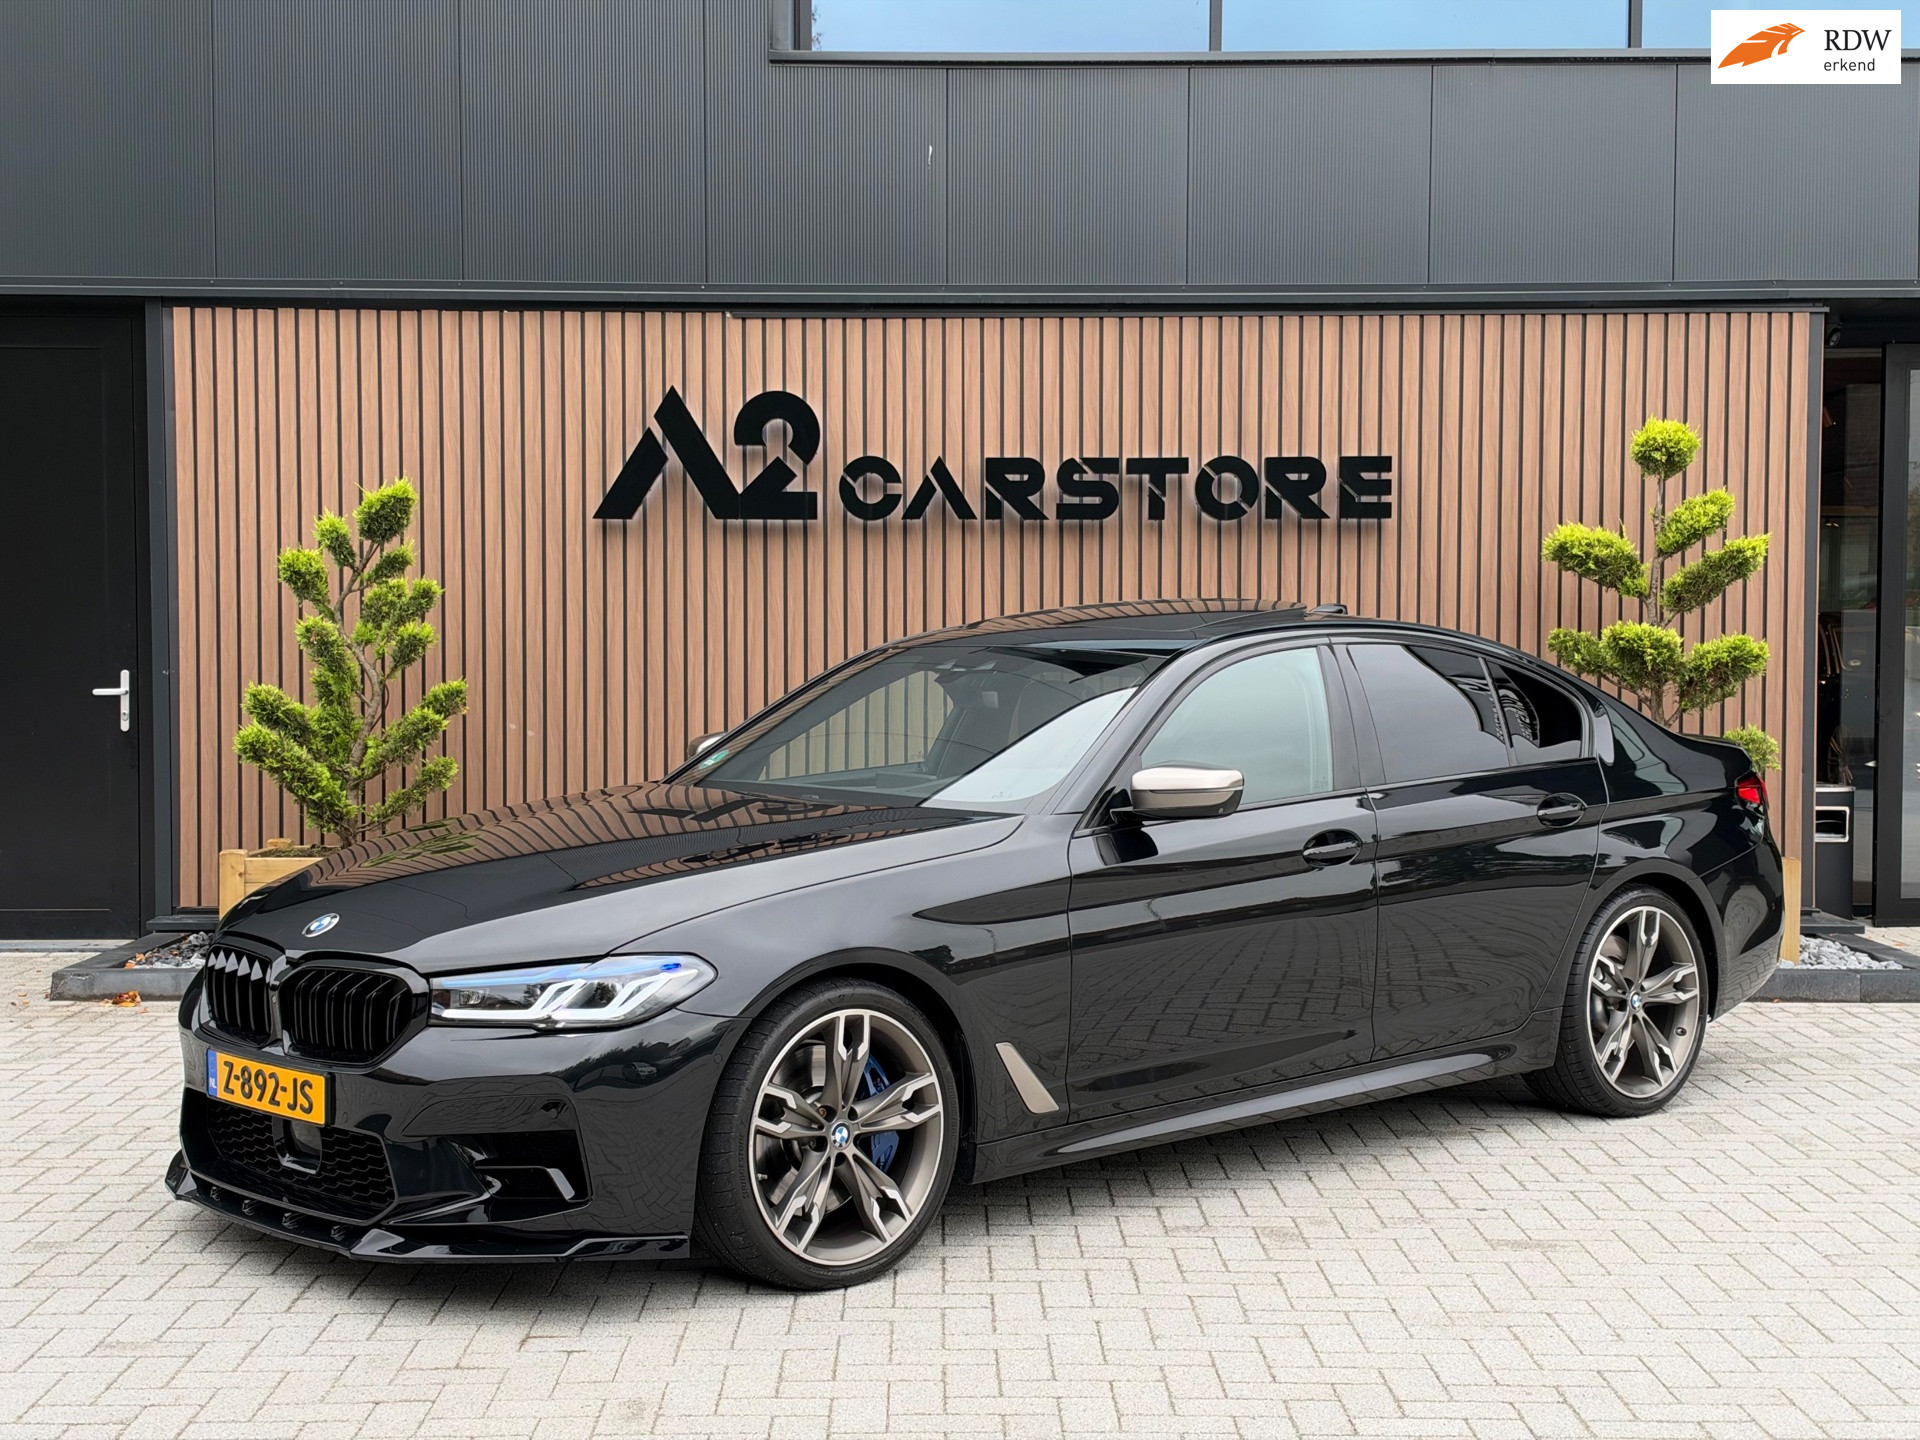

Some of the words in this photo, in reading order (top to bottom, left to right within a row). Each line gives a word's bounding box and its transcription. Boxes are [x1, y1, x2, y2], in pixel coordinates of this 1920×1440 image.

[593, 385, 821, 520] A2
[838, 455, 1393, 521] CARSTORE
[209, 1076, 217, 1089] NL
[223, 1060, 314, 1115] Z-892-JS
